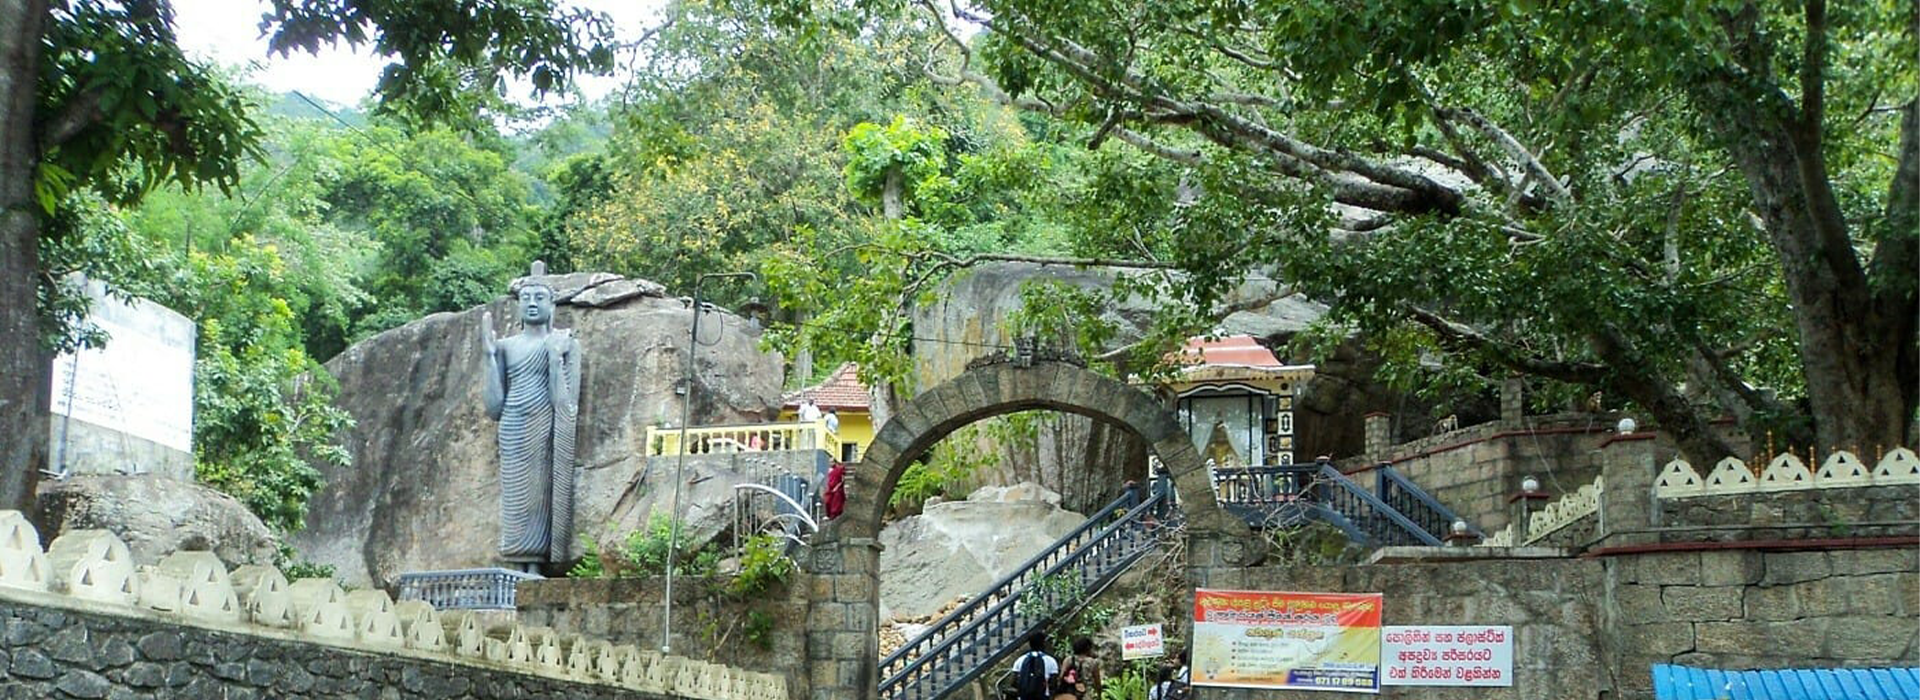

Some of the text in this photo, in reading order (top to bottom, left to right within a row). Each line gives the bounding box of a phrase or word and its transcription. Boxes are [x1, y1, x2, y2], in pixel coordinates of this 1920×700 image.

[1435, 633, 1453, 643] සහ
[1457, 629, 1504, 645] ප්ලාස්ටික්
[1390, 666, 1406, 679] එක්
[1411, 665, 1451, 679] කිරීමෙන්
